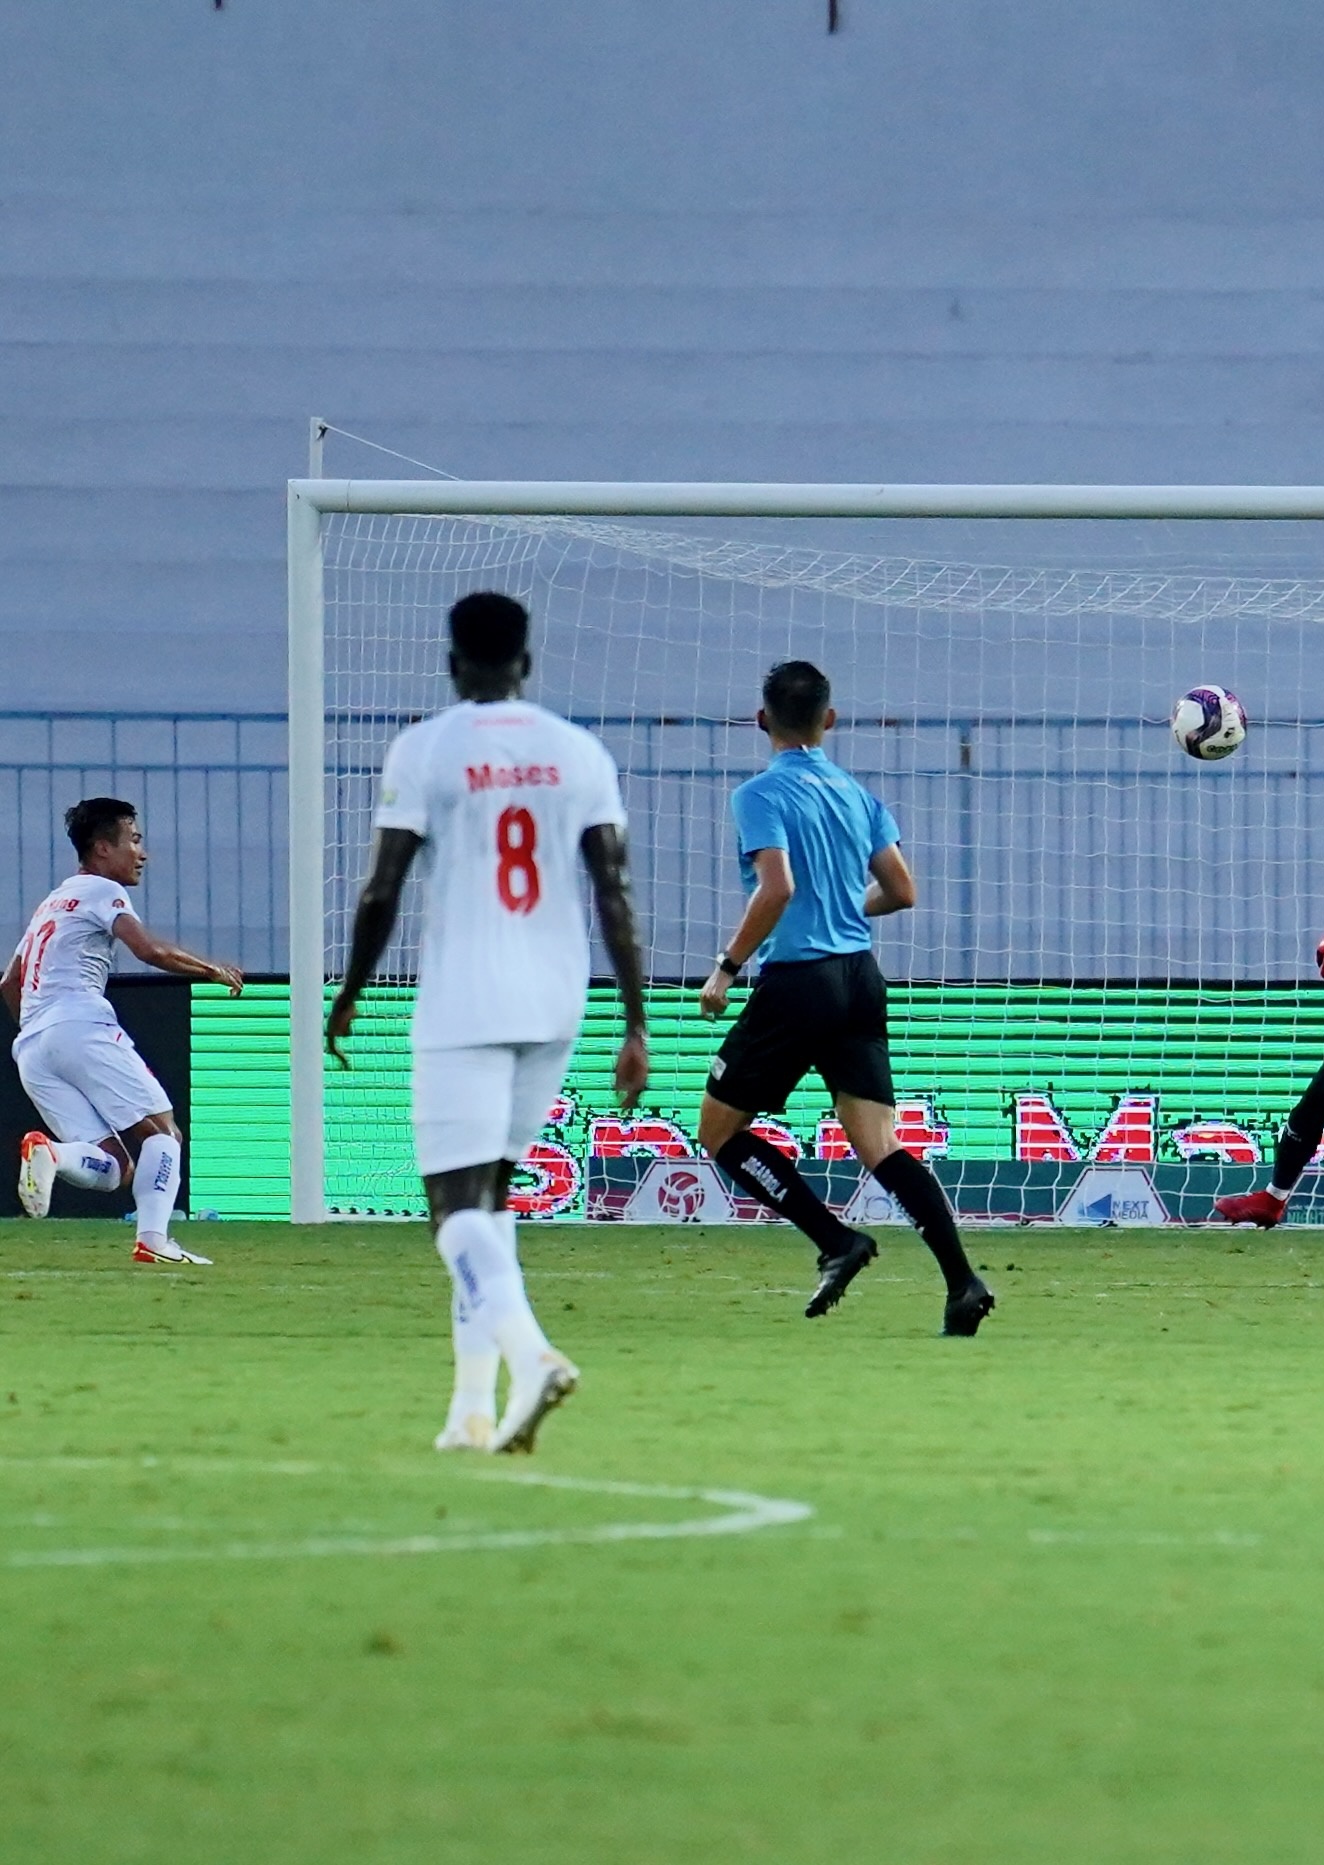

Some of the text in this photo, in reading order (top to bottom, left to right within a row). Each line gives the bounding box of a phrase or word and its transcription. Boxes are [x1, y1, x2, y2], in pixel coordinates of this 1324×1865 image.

[466, 763, 560, 793] Moses
[497, 804, 541, 916] 8
[1111, 1211, 1149, 1220] MEDIA
[1112, 1201, 1150, 1211] NEXT
